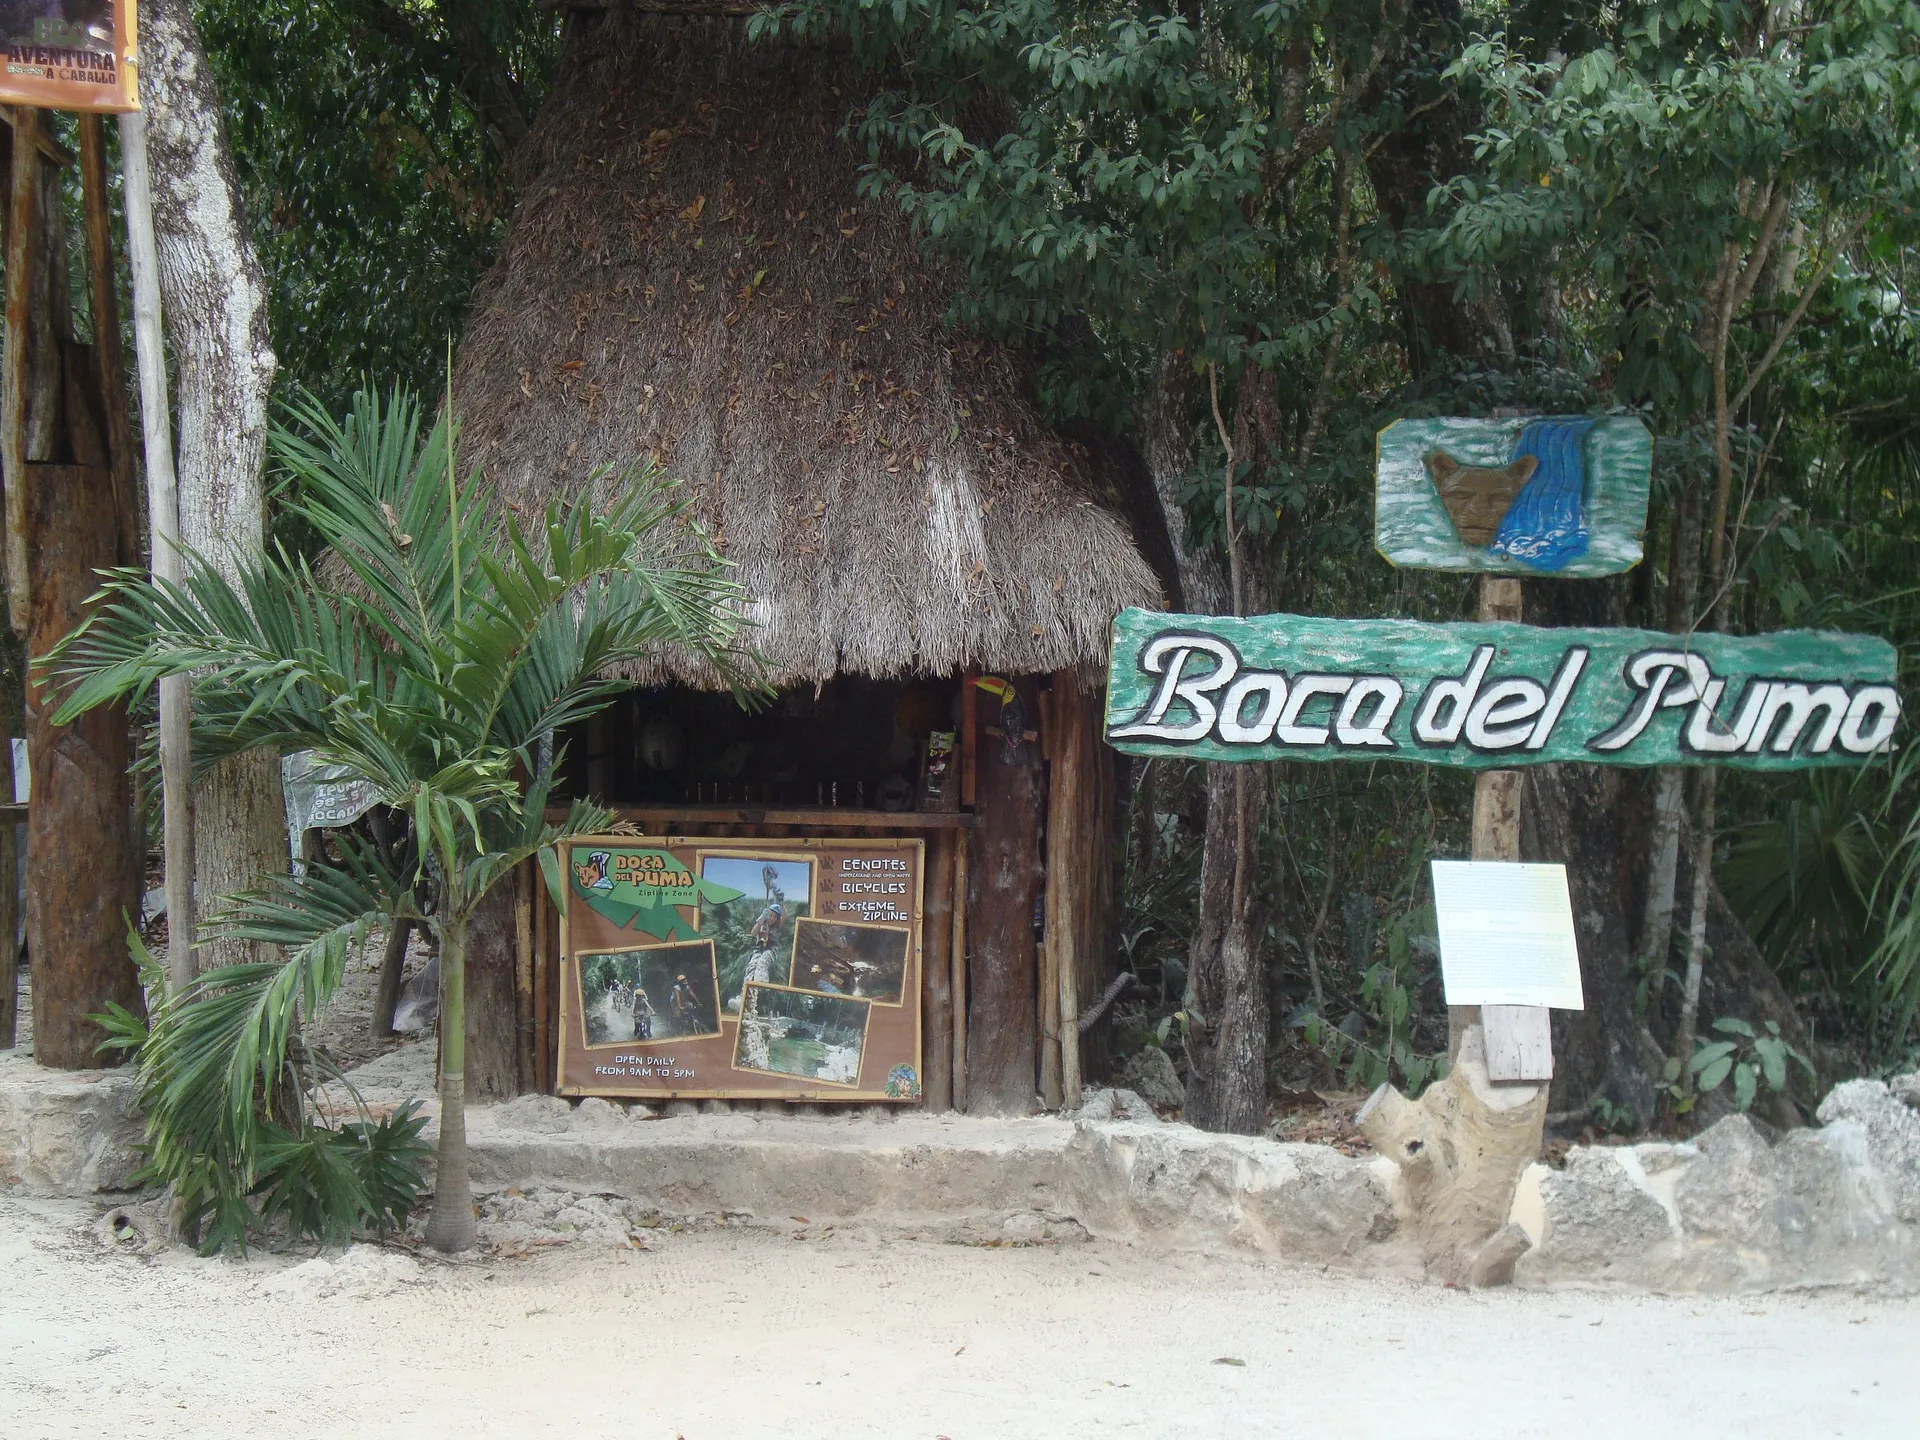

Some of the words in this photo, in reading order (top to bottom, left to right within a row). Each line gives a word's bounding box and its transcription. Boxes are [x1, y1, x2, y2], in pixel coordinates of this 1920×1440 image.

[7, 45, 115, 71] AVENTURA
[46, 67, 55, 79] A
[59, 69, 116, 85] CABALLO
[1108, 632, 1398, 746] Boca
[1413, 645, 1588, 750] del
[1588, 650, 1902, 753] Puma
[615, 855, 666, 869] BOCA
[842, 859, 907, 871] CENOTES
[614, 873, 632, 881] DEL
[632, 870, 695, 887] PUMA
[638, 889, 669, 897] Zipline
[842, 882, 906, 894] BICYCLES
[839, 901, 896, 912] EXTREME
[862, 911, 909, 921] ZIPLINE
[615, 1055, 643, 1065] OPEN
[647, 1056, 675, 1066] DAILY
[594, 1066, 626, 1076] FROM
[629, 1067, 652, 1077] 9AM
[656, 1068, 670, 1077] TO
[674, 1069, 696, 1078] 5PM
